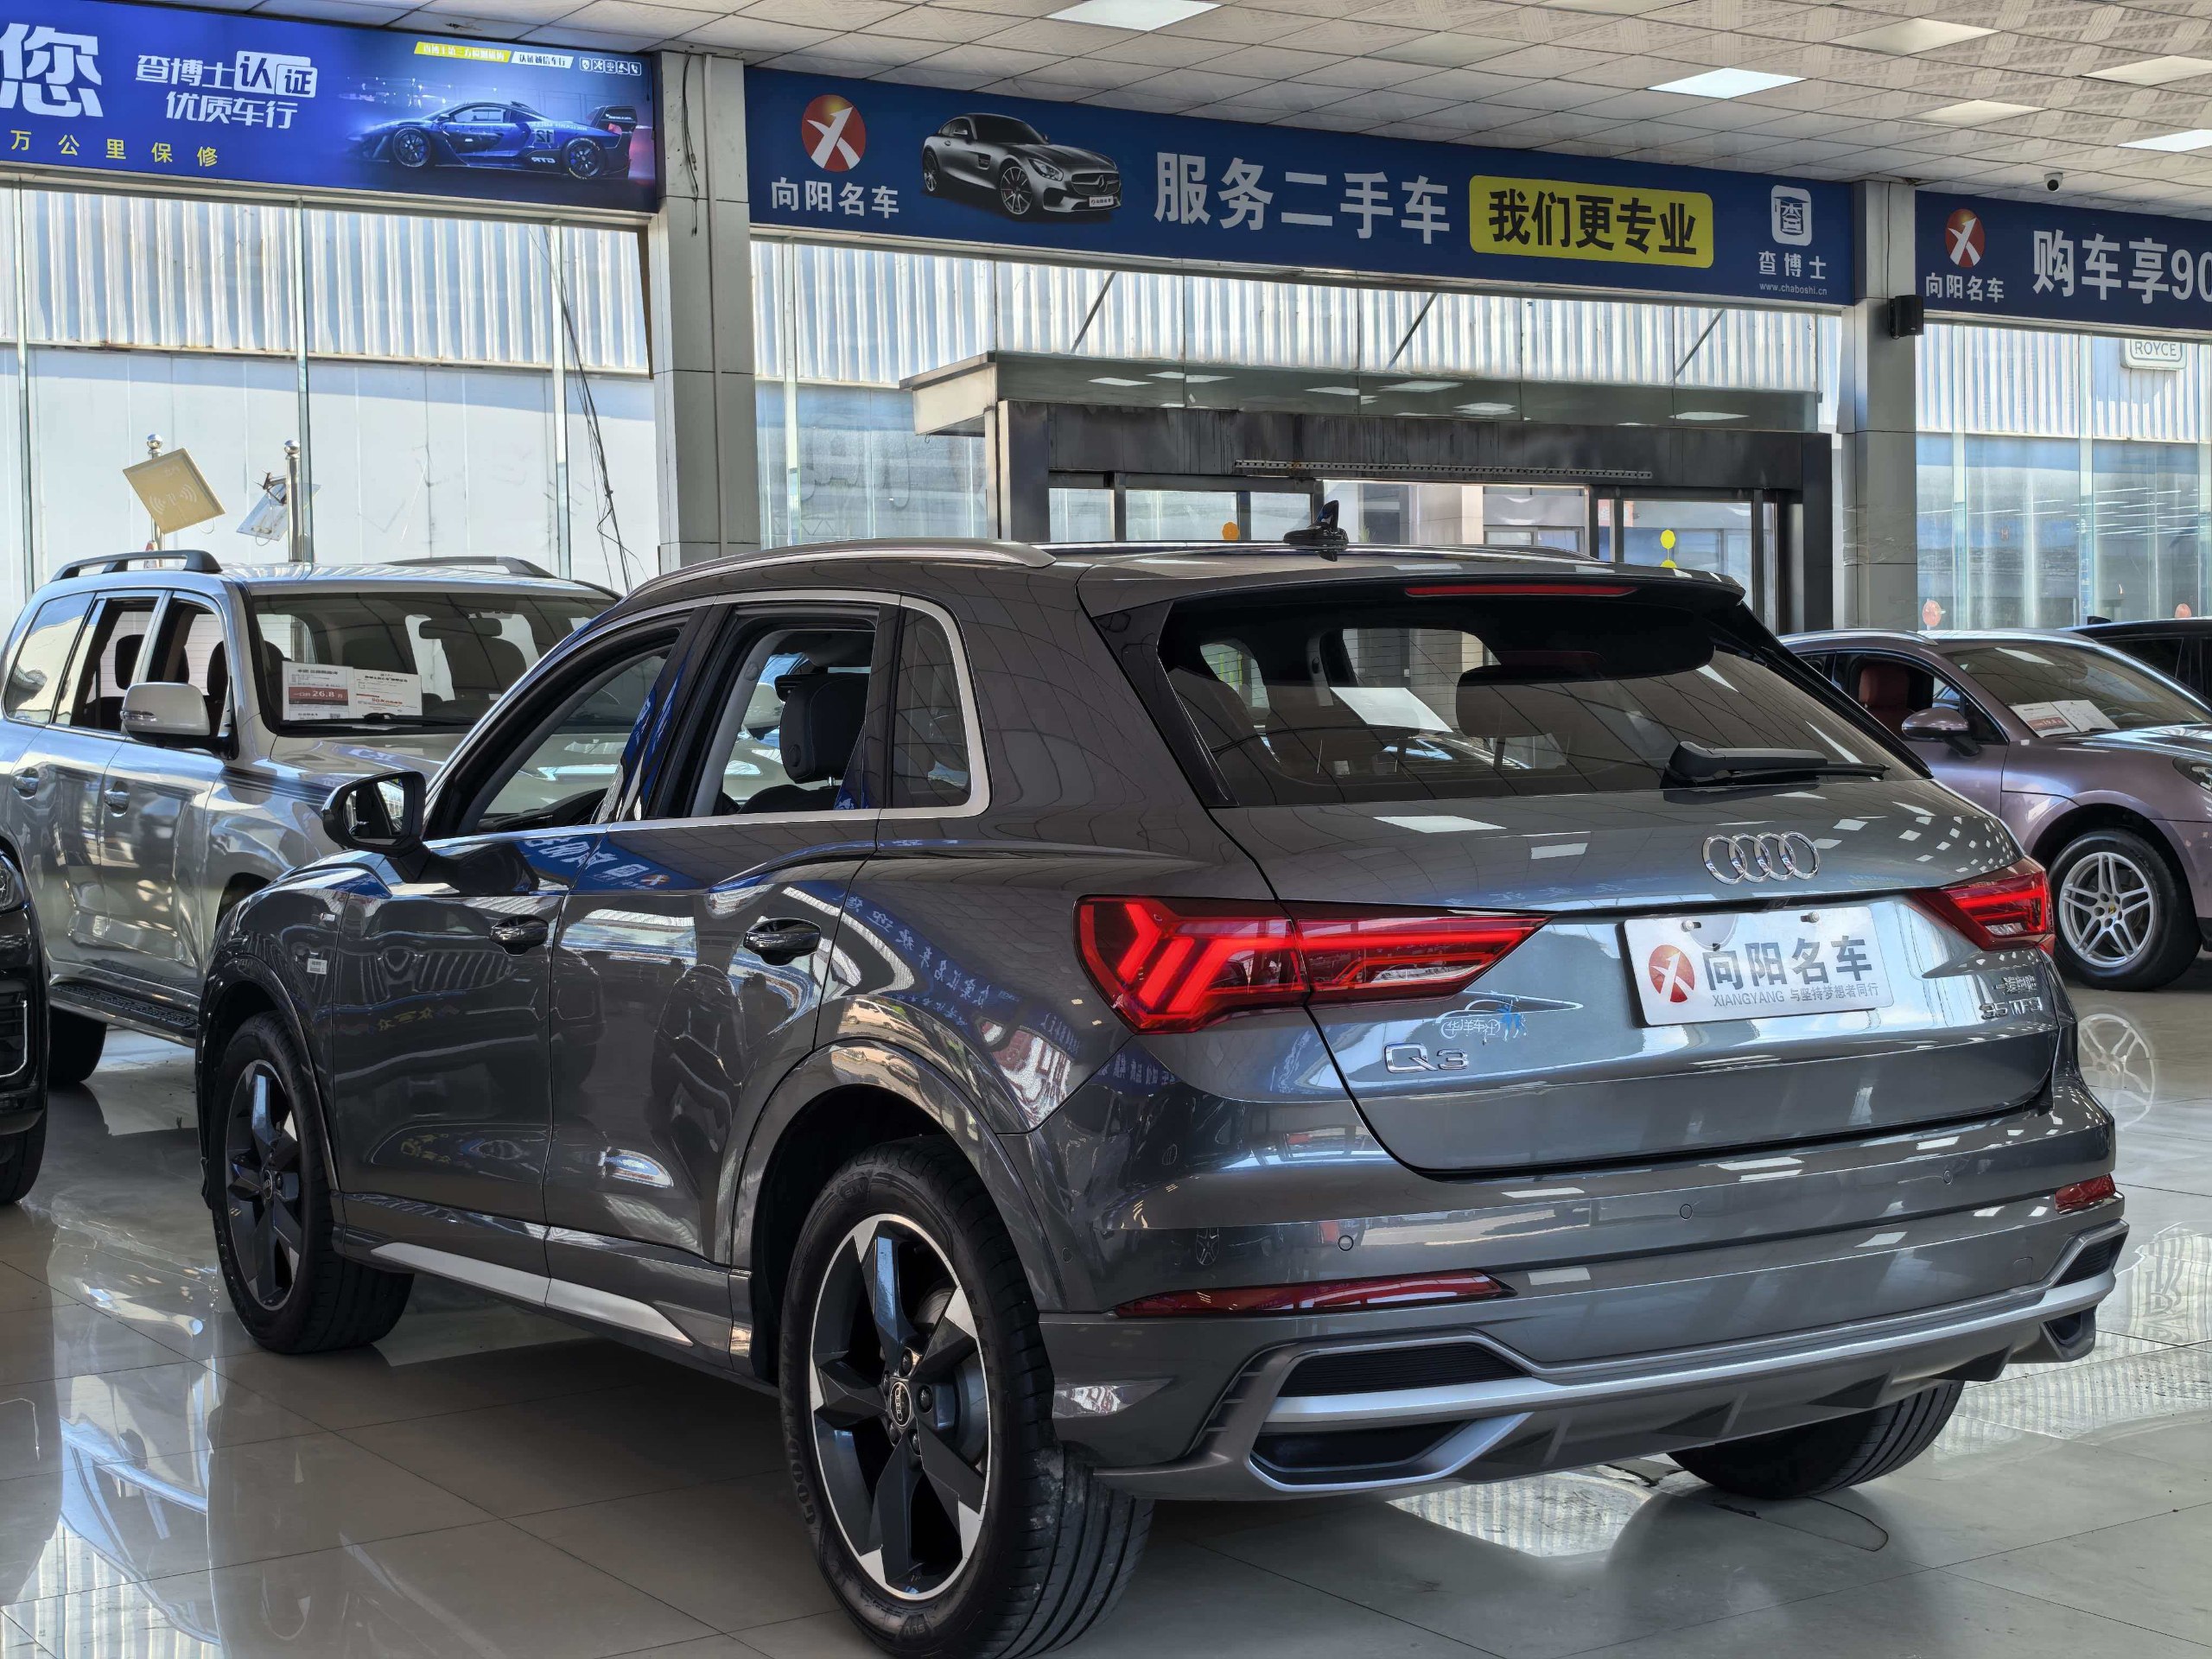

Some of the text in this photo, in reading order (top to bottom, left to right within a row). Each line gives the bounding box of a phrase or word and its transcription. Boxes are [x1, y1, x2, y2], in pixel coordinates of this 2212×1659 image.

[0, 22, 104, 118] 您
[136, 52, 317, 98] 查博士认证
[165, 91, 298, 130] 优质车行
[10, 130, 218, 167] 万公里保修
[771, 176, 899, 219] 向阳名车
[1154, 151, 1450, 245] 服务二手车
[1489, 188, 1697, 255] 我们更专业
[1758, 251, 1827, 279] 查博士
[1759, 283, 1827, 296] www.chaboshi.cn
[1925, 272, 2005, 302] 向阳名车
[2134, 341, 2177, 357] ROYCE
[1702, 935, 1872, 991] 向阳名车
[1713, 982, 1878, 1007] XIANGYANG 与坚持梦想者同行
[1383, 1042, 1469, 1073] Q3
